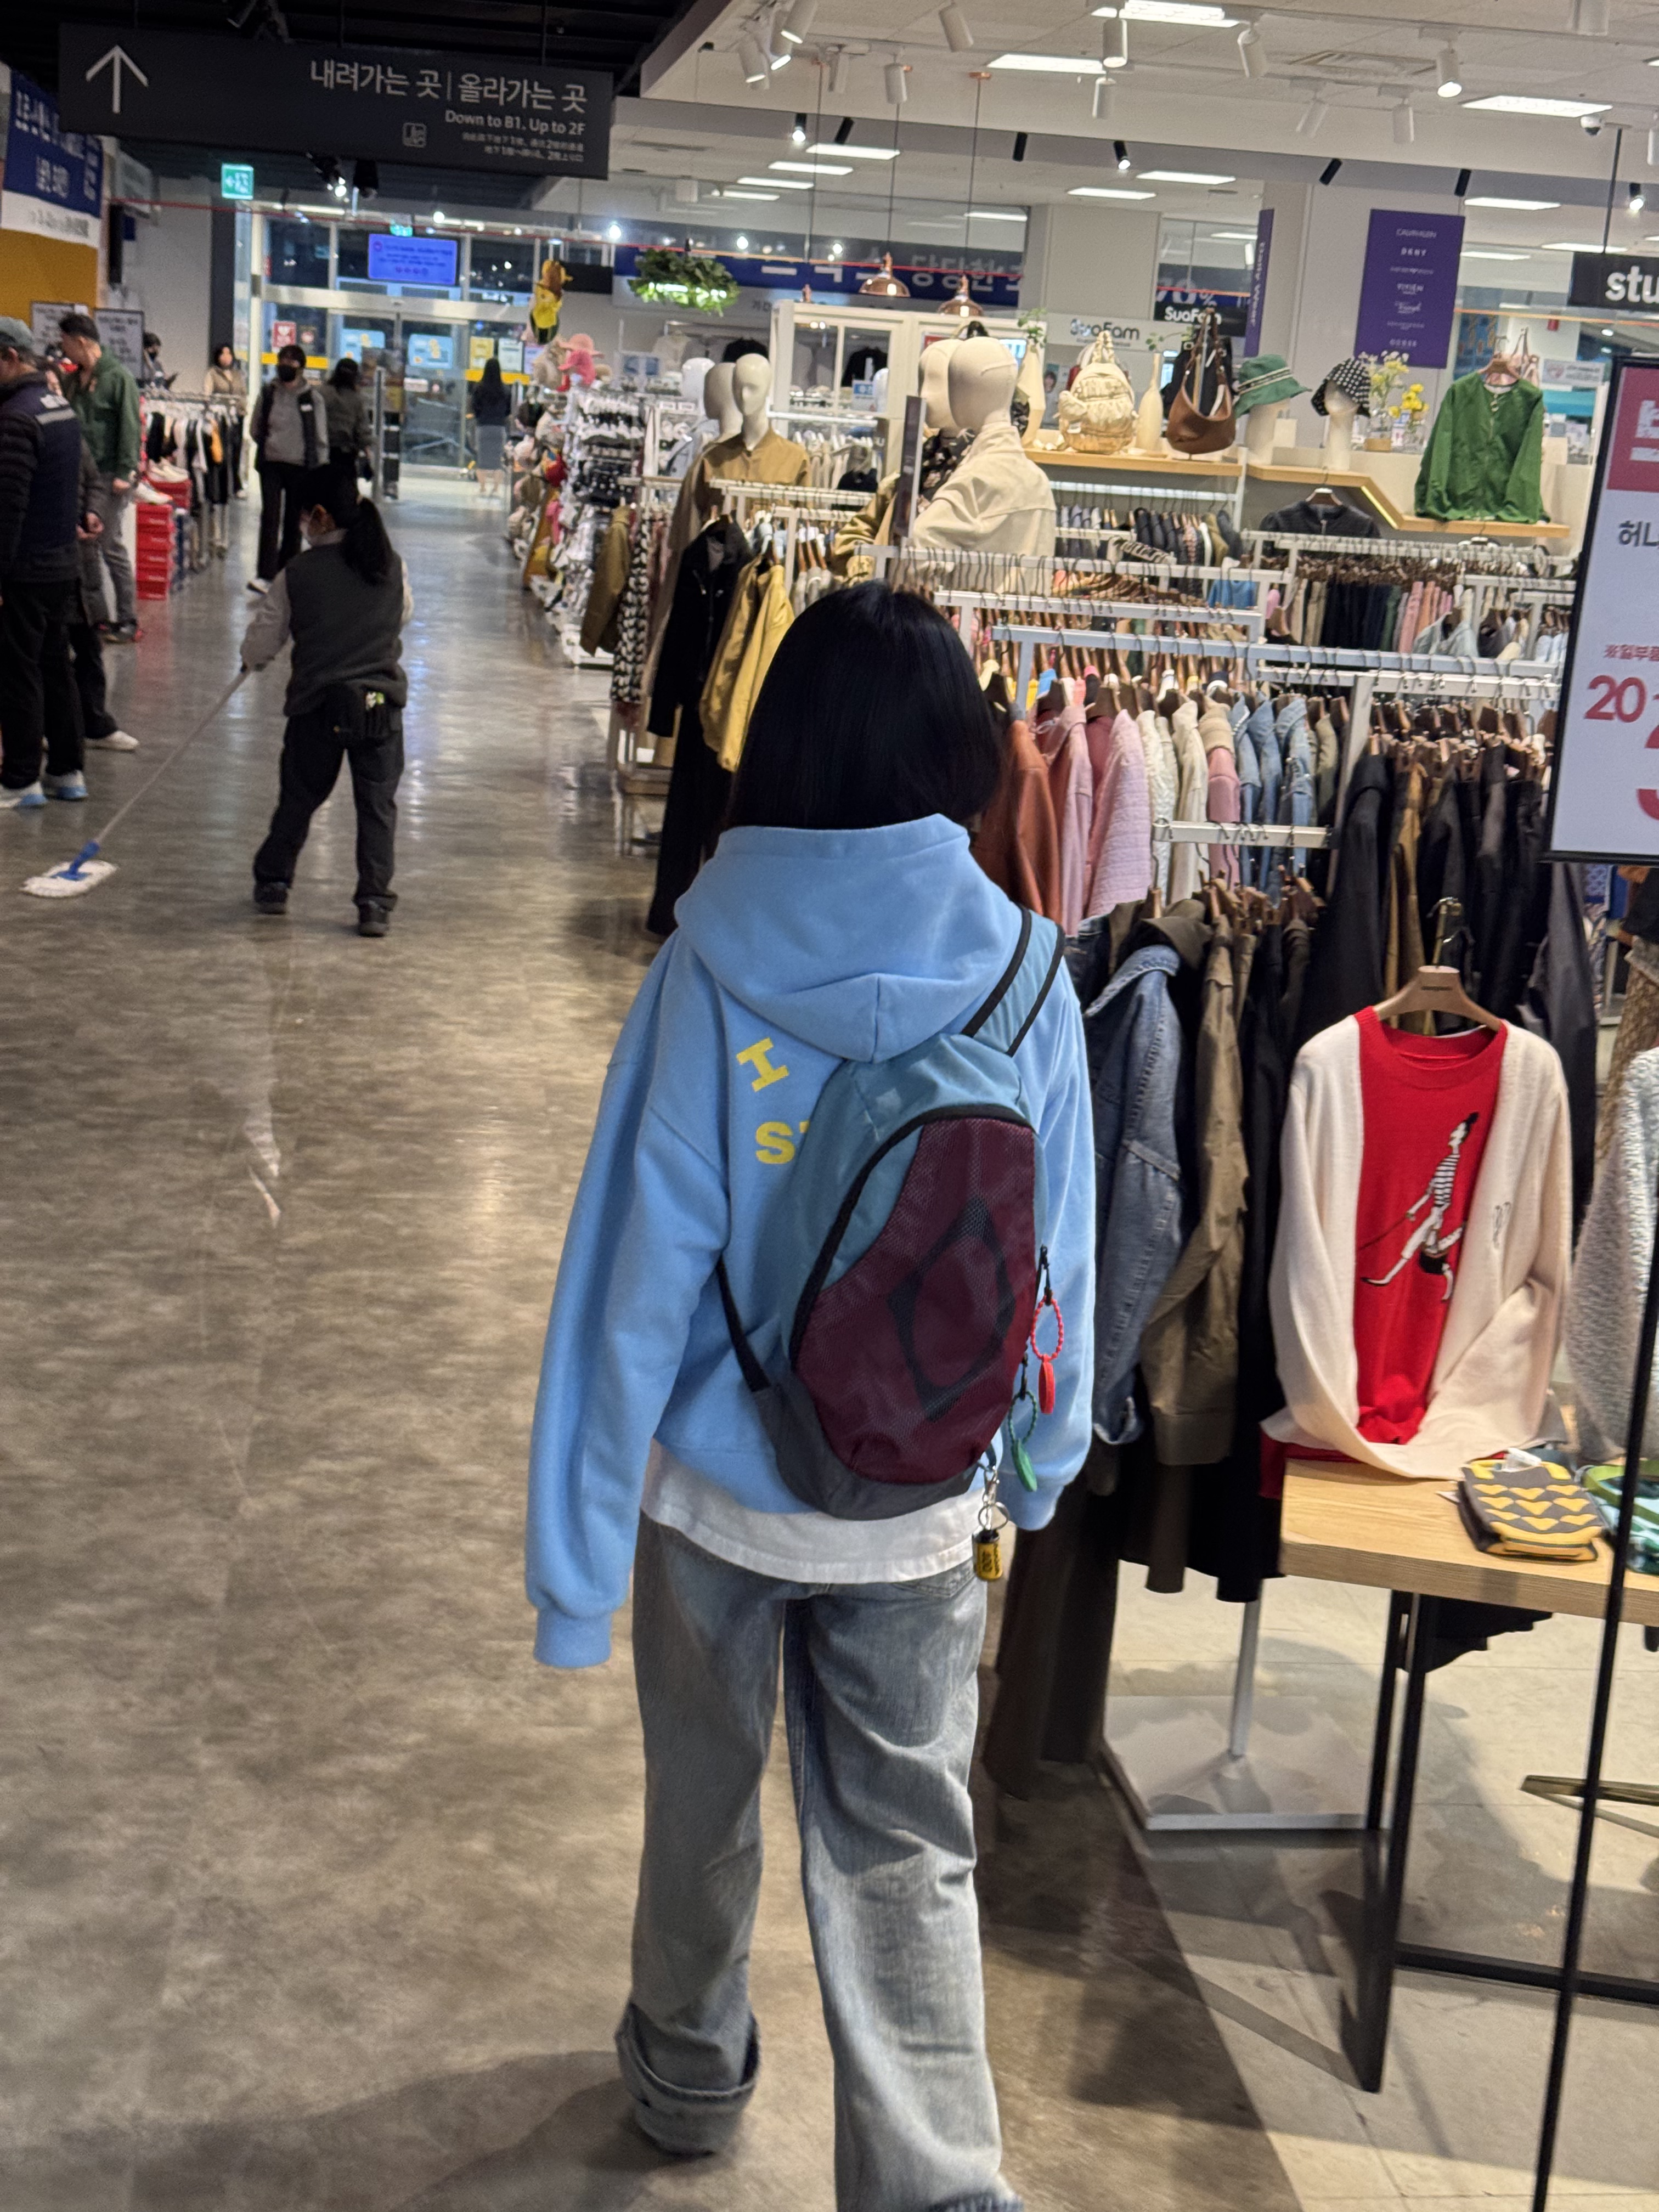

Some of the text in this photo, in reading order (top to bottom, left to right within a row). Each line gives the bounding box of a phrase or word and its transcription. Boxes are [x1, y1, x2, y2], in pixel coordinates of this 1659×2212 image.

[311, 59, 588, 114] 내려가는 곳 올라가는 곳
[445, 110, 485, 126] Down
[487, 114, 503, 128] to
[529, 117, 549, 135] Up
[551, 120, 567, 134] to
[568, 122, 586, 136] 2F
[755, 1121, 810, 1164] S
